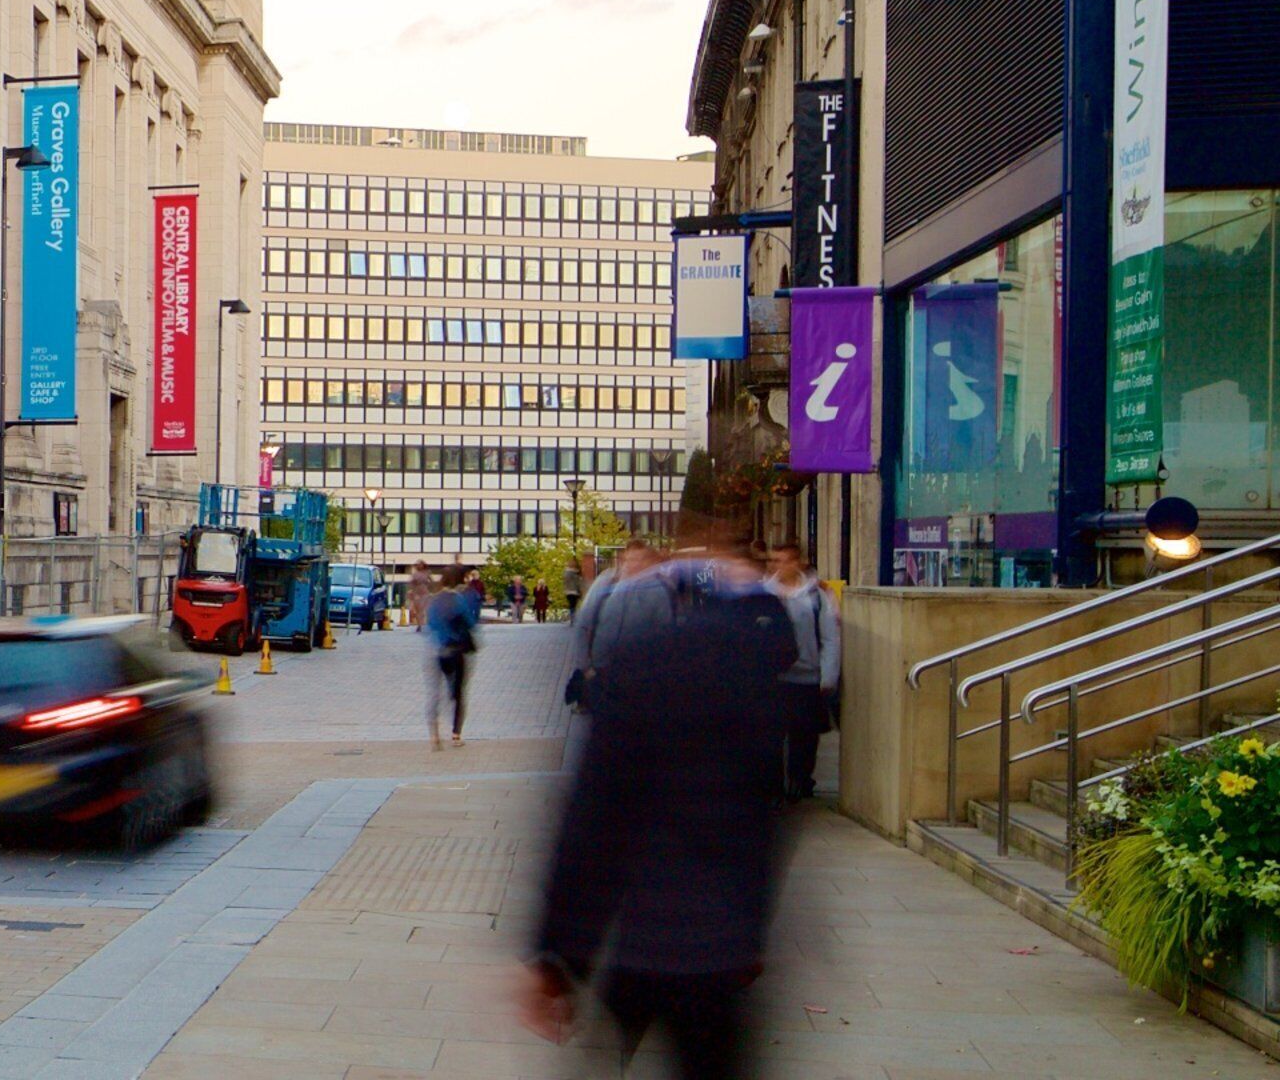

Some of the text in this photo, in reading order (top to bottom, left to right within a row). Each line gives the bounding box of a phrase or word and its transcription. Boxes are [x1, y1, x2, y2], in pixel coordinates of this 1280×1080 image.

[818, 94, 843, 112] THE
[45, 101, 70, 252] Graves Gallery
[817, 113, 838, 288] FITNES
[702, 249, 721, 261] The
[175, 206, 190, 336] CENTRAL LIBRARY
[680, 264, 742, 280] GRADUATE
[30, 381, 66, 389] GALLERY
[161, 357, 175, 404] MUSIC
[30, 396, 55, 404] SHOP
[52, 389, 59, 397] &
